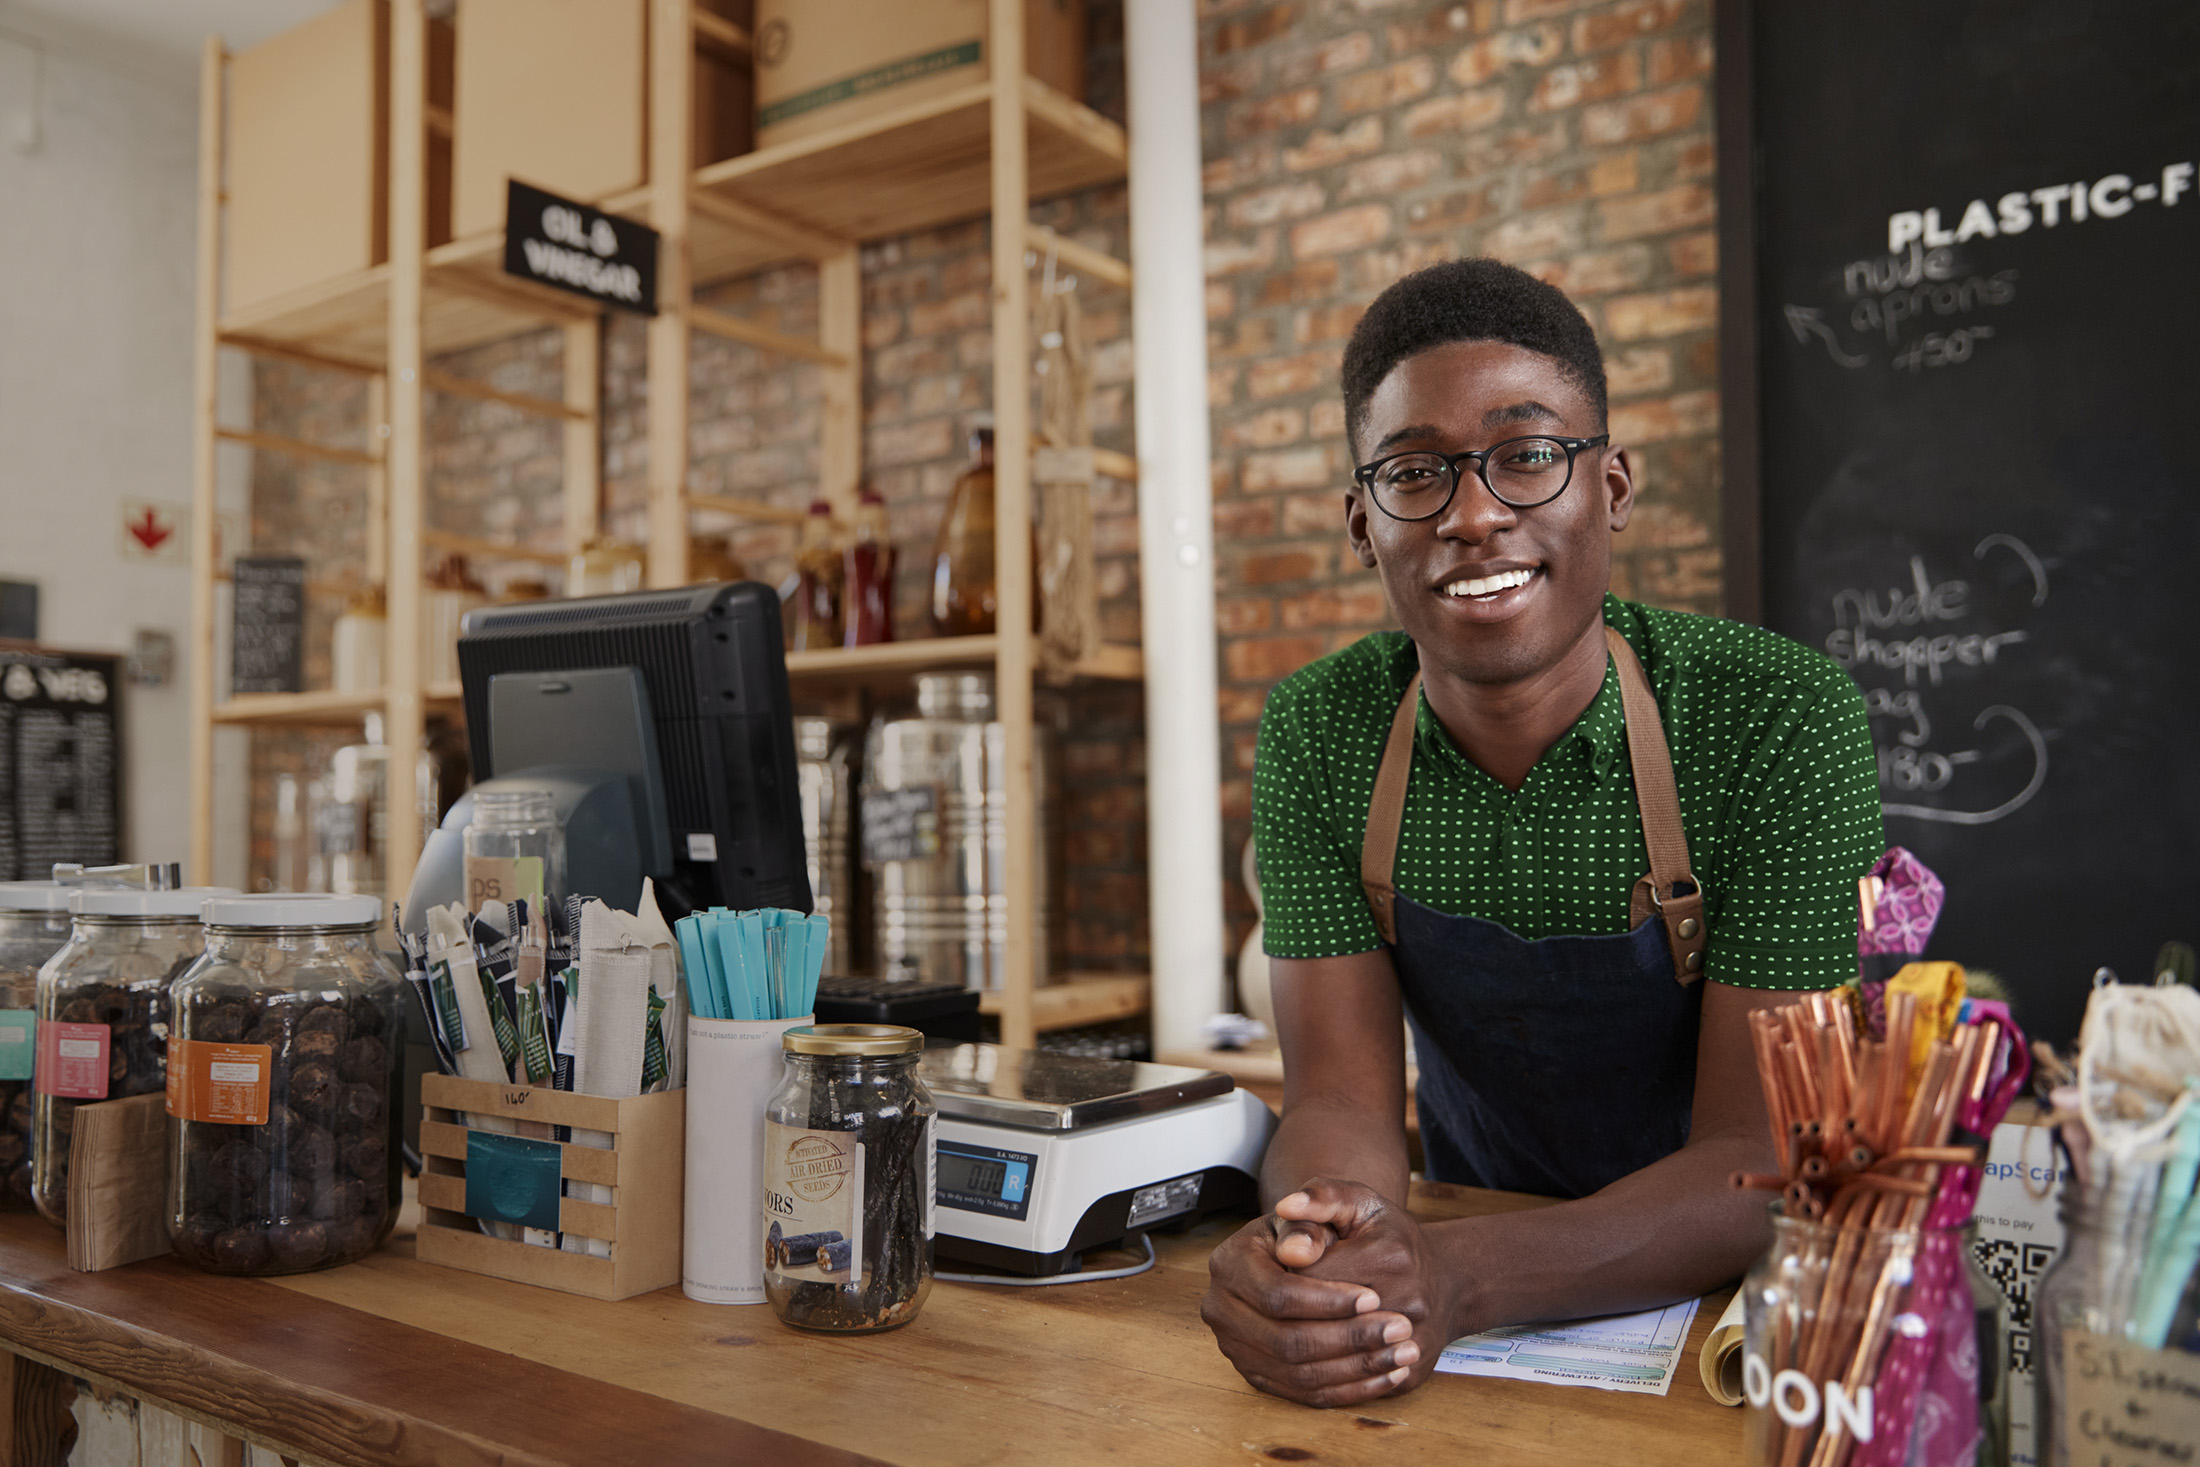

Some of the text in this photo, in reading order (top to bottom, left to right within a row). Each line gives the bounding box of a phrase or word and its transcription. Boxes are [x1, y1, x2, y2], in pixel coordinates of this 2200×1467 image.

[1887, 160, 2200, 254] PLASTIC-F
[541, 204, 619, 258] OIL &
[522, 237, 643, 303] VINEGAR
[1851, 268, 2020, 347] aprons
[1832, 554, 1970, 630] nude
[1825, 624, 2029, 687] shopper
[3, 662, 39, 701] &
[1861, 687, 1931, 748] ag
[714, 1031, 738, 1041] plastic
[789, 1158, 842, 1179] AIR DRIED
[804, 1179, 832, 1193] SEEDS
[1008, 1174, 1020, 1191] R
[765, 1188, 794, 1215] ORS
[1976, 1214, 2035, 1232] this to pay
[1609, 1376, 1661, 1388] DELIVERY
